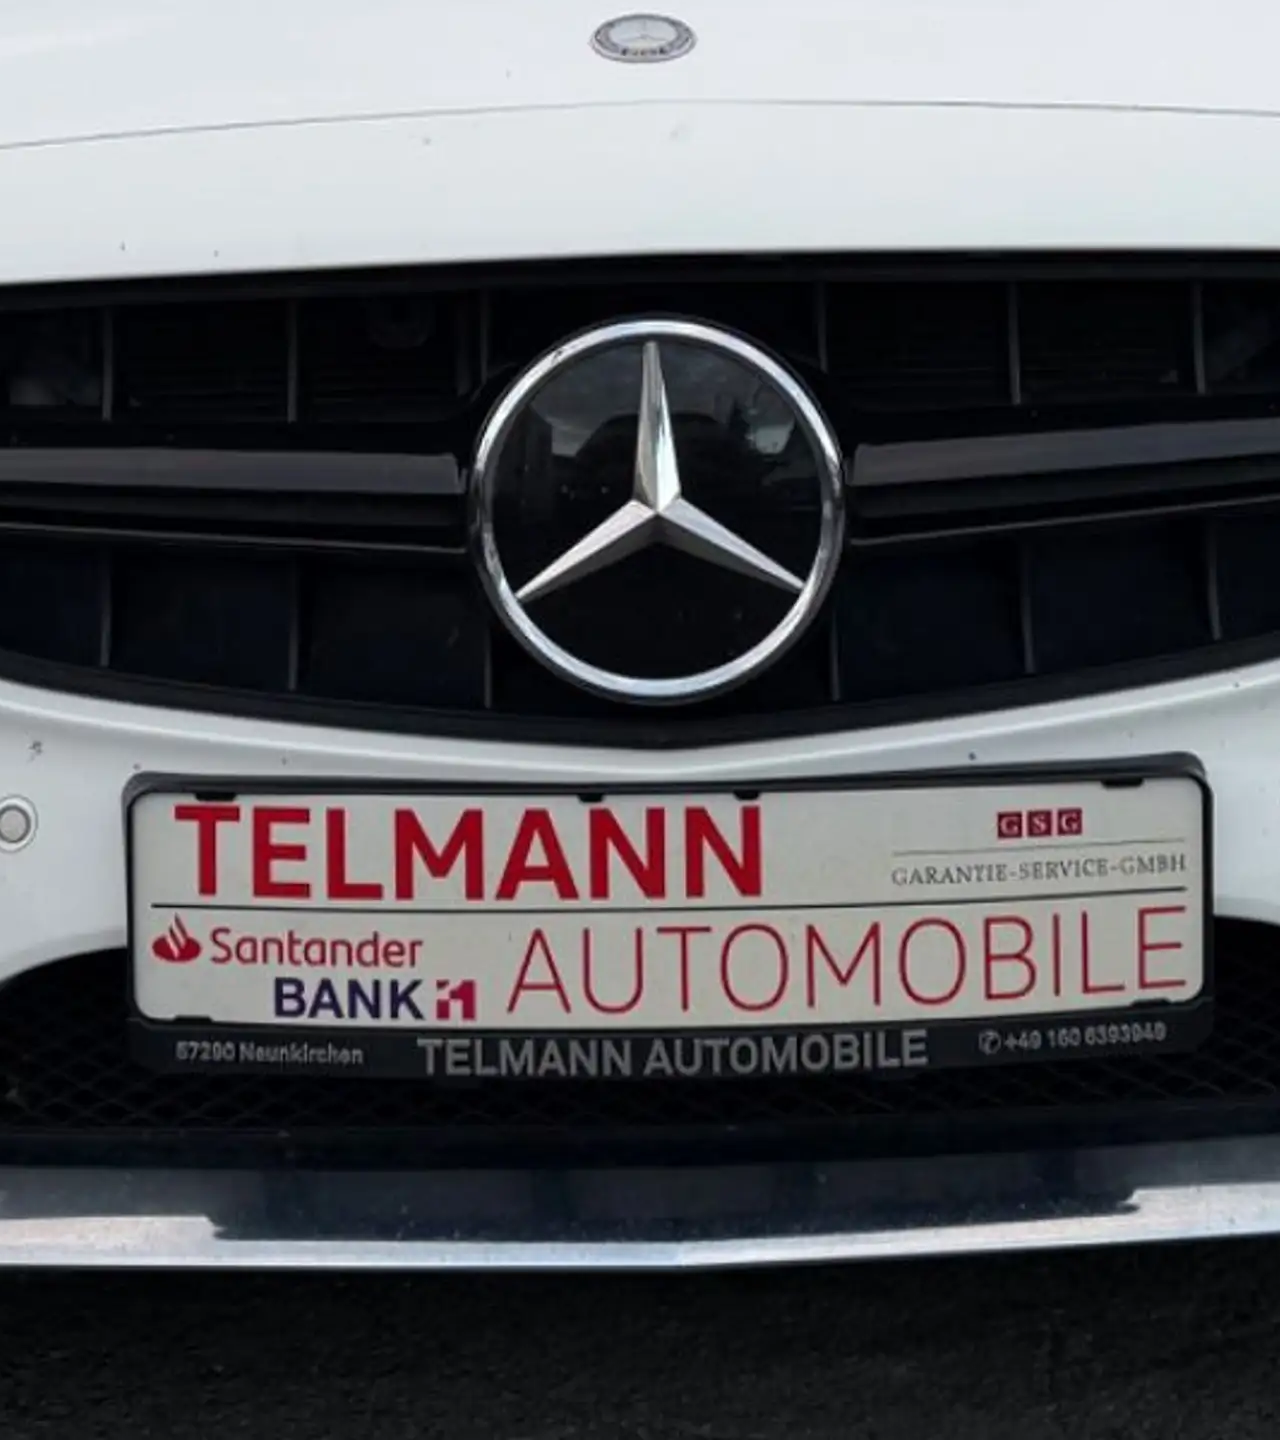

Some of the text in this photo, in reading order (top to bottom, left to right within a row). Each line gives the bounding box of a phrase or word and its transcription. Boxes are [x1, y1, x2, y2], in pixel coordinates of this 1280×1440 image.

[998, 808, 1083, 839] GSG
[174, 804, 762, 901] TELMANN
[209, 926, 424, 969] Santander
[507, 905, 1188, 1014] AUTOMOBILE
[239, 1038, 364, 1065] Neunkirchen
[416, 1029, 928, 1077] TELMANN AUTOMOBILE
